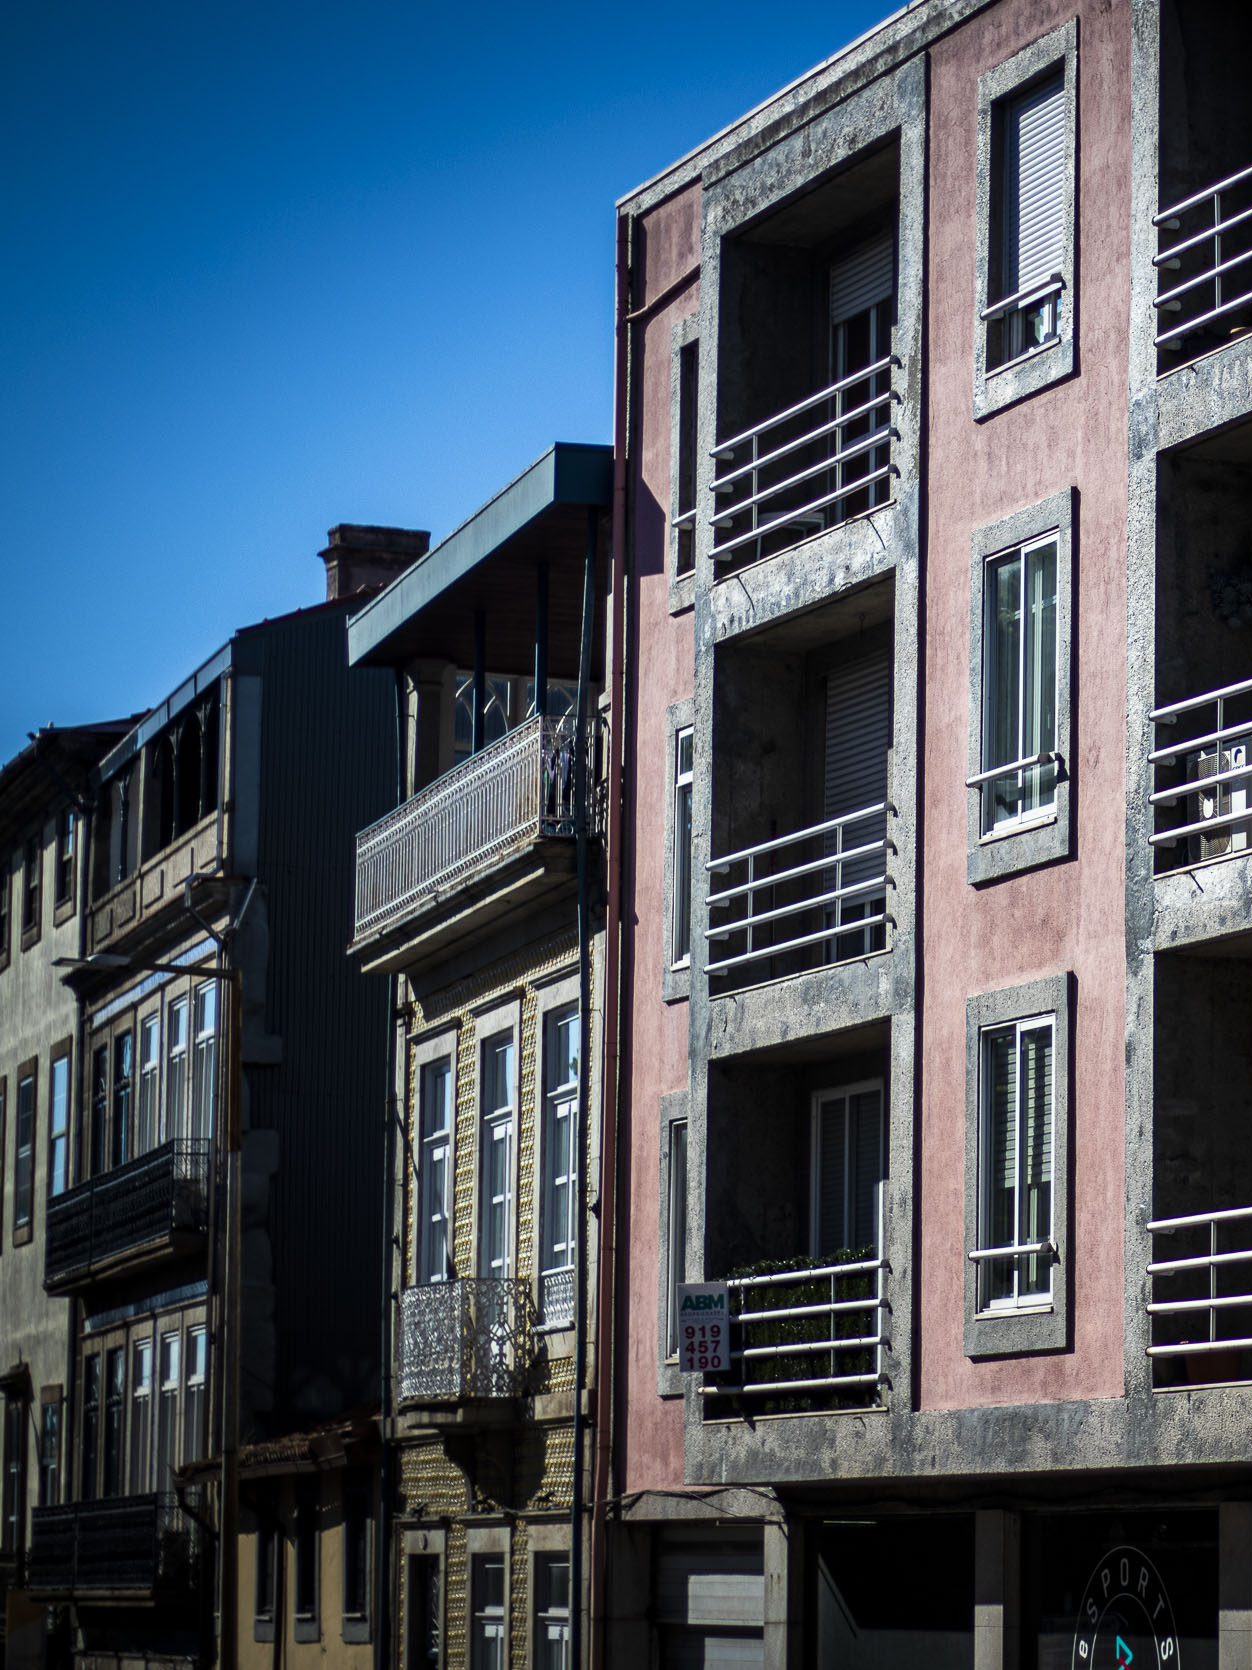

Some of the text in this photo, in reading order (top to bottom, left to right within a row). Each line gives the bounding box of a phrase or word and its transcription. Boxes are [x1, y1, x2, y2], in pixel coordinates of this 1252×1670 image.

[681, 1294, 725, 1311] ABM
[684, 1324, 721, 1340] 919
[685, 1340, 721, 1355] 457
[687, 1355, 722, 1370] 190
